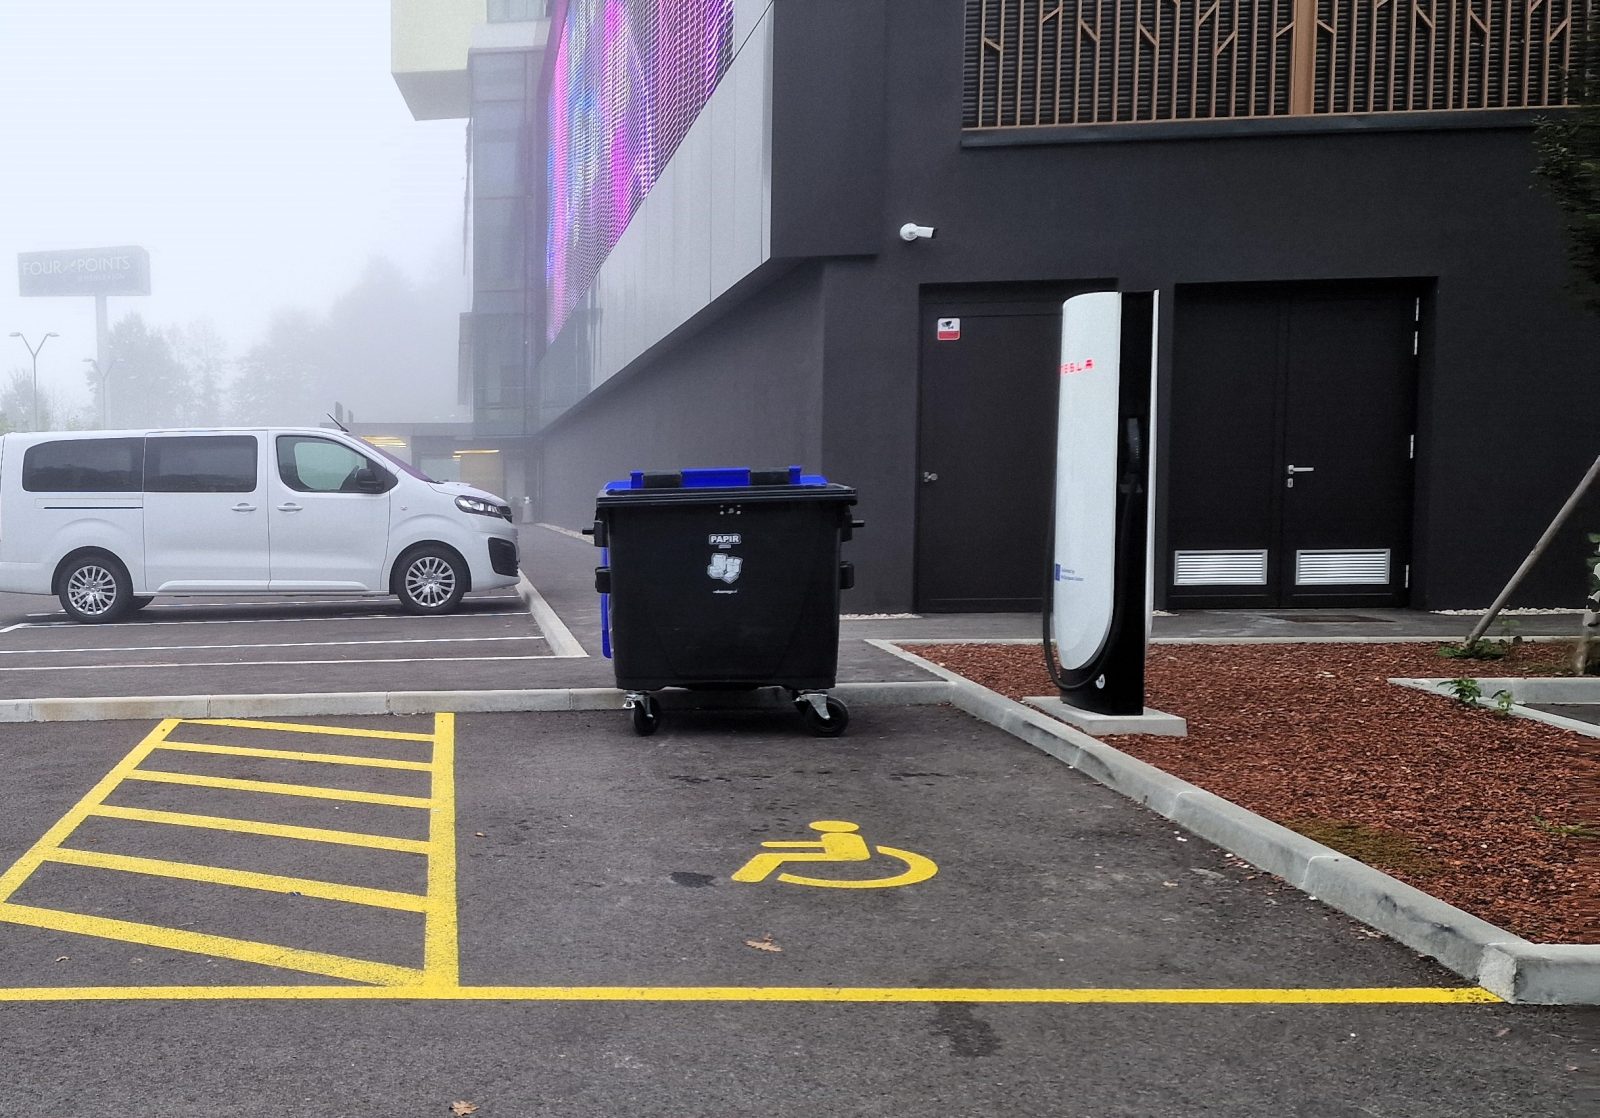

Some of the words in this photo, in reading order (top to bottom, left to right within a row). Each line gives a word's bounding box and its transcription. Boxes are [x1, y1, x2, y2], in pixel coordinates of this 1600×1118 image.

[22, 259, 63, 276] FOUR
[78, 255, 130, 272] POINTS
[711, 535, 739, 543] PAPIR
